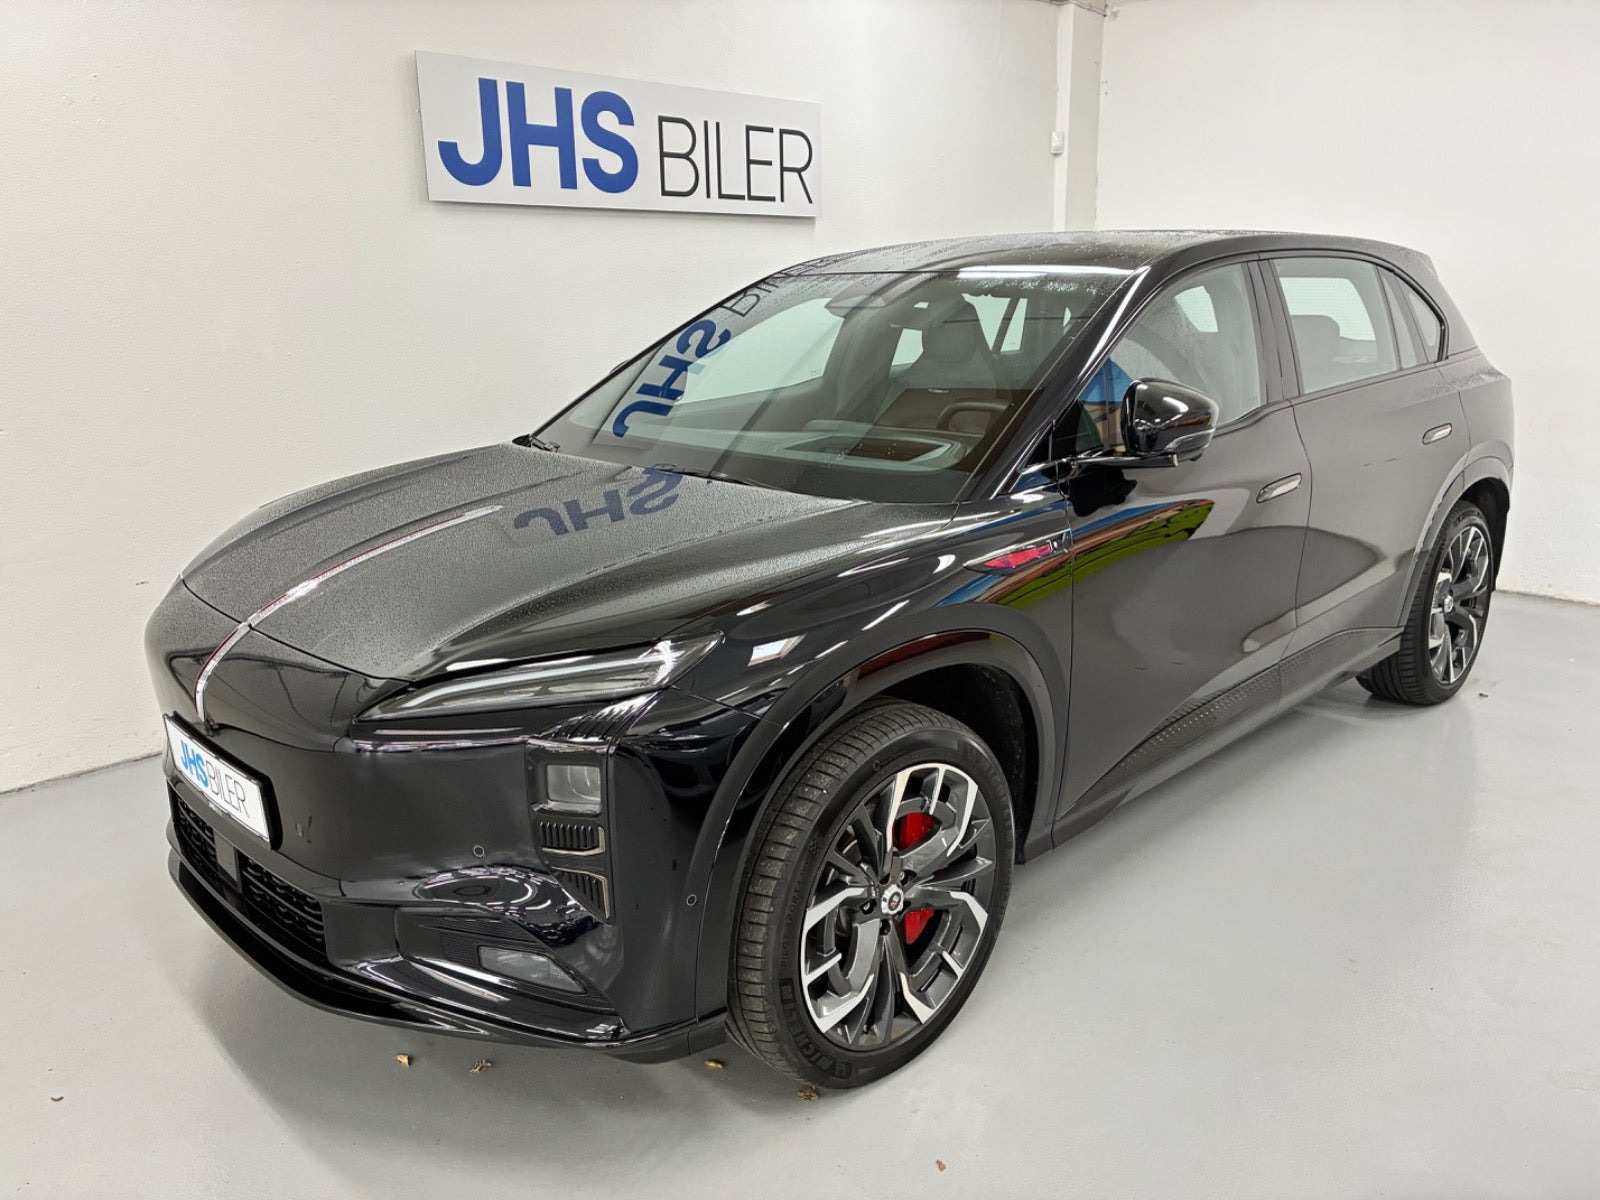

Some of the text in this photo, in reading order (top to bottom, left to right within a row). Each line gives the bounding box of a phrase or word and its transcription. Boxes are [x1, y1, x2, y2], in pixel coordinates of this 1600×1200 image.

[437, 77, 814, 204] JHS BILER
[181, 739, 249, 818] JHS BILER
[780, 984, 834, 1072] MICHELIN
